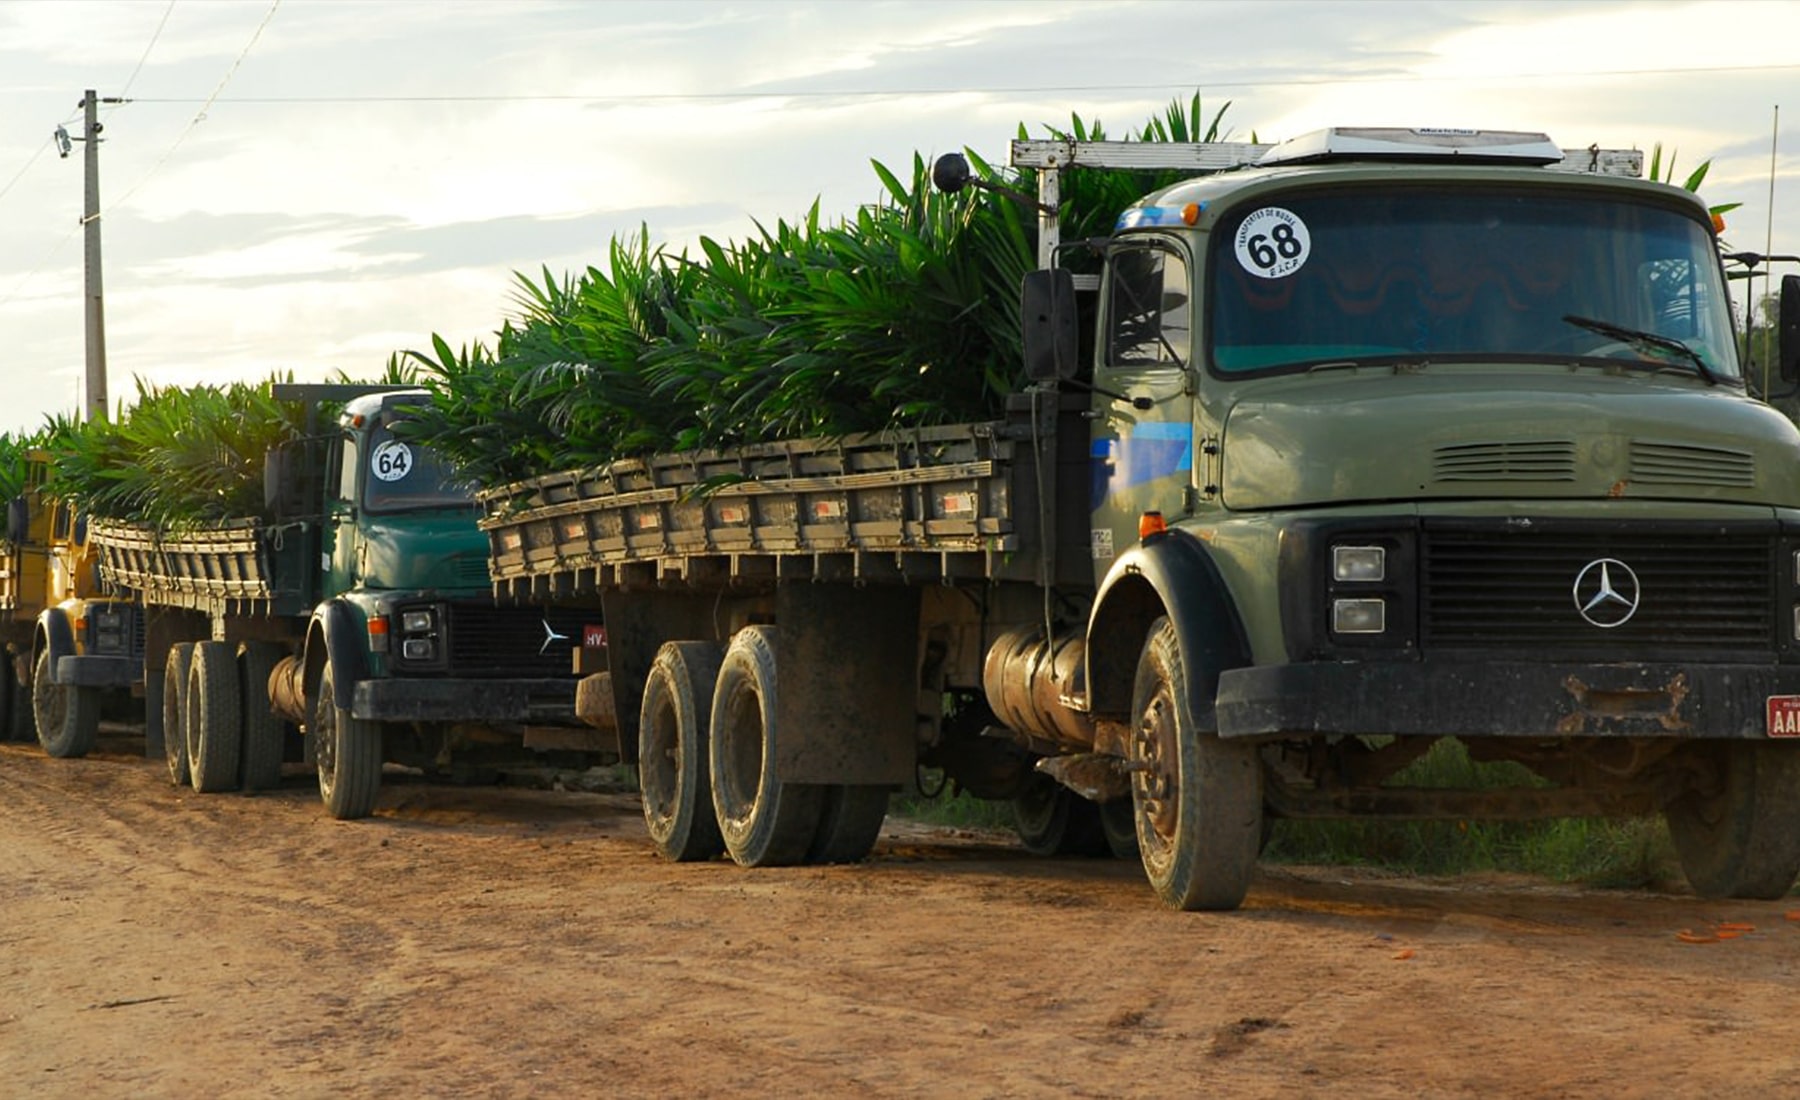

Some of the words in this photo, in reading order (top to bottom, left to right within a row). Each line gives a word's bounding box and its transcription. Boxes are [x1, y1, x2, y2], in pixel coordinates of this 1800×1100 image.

[1247, 223, 1302, 270] 68
[379, 451, 407, 474] 64
[1773, 710, 1800, 733] AA
